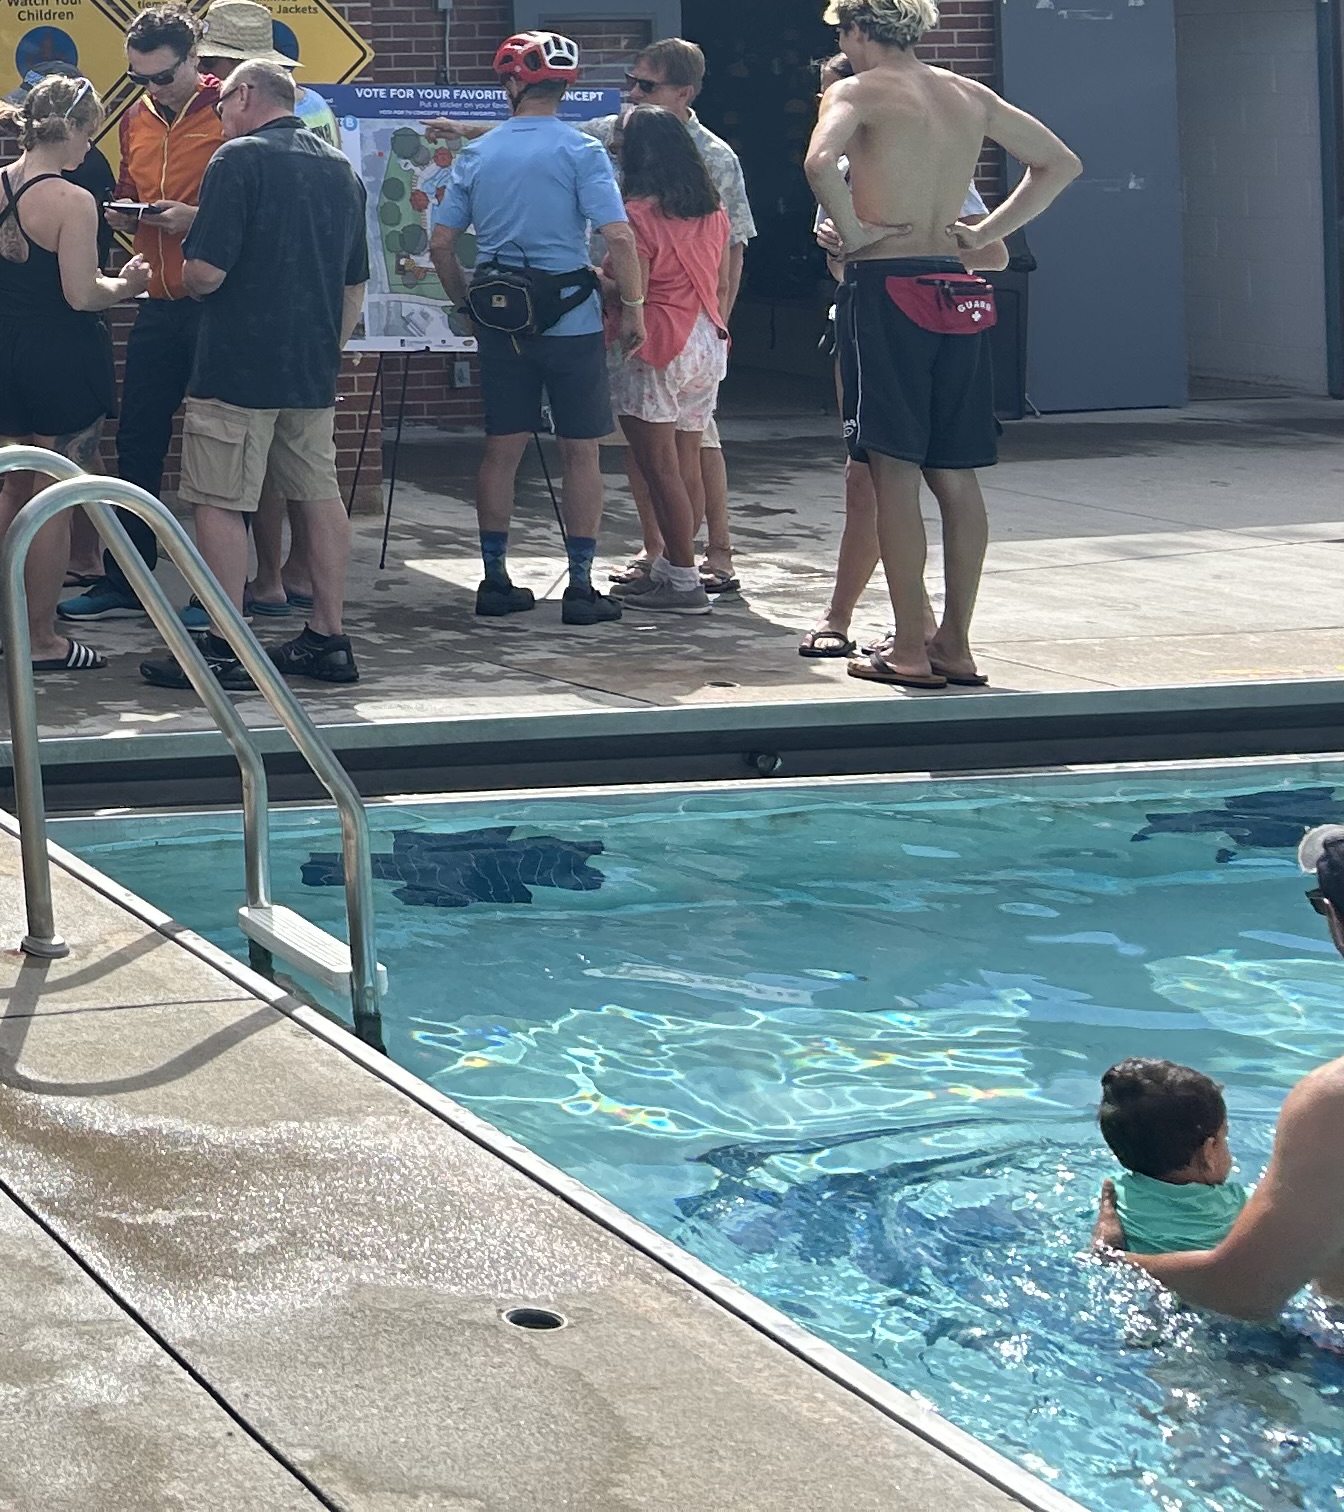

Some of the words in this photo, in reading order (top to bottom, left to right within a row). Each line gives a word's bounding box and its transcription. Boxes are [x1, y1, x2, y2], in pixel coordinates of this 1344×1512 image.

[137, 0, 169, 9] tiem
[277, 4, 318, 14] Jackets
[17, 9, 74, 21] Children
[355, 88, 387, 99] VOTE
[389, 88, 414, 99] FOR
[417, 89, 450, 99] YOUR
[957, 300, 992, 313] GUARD
